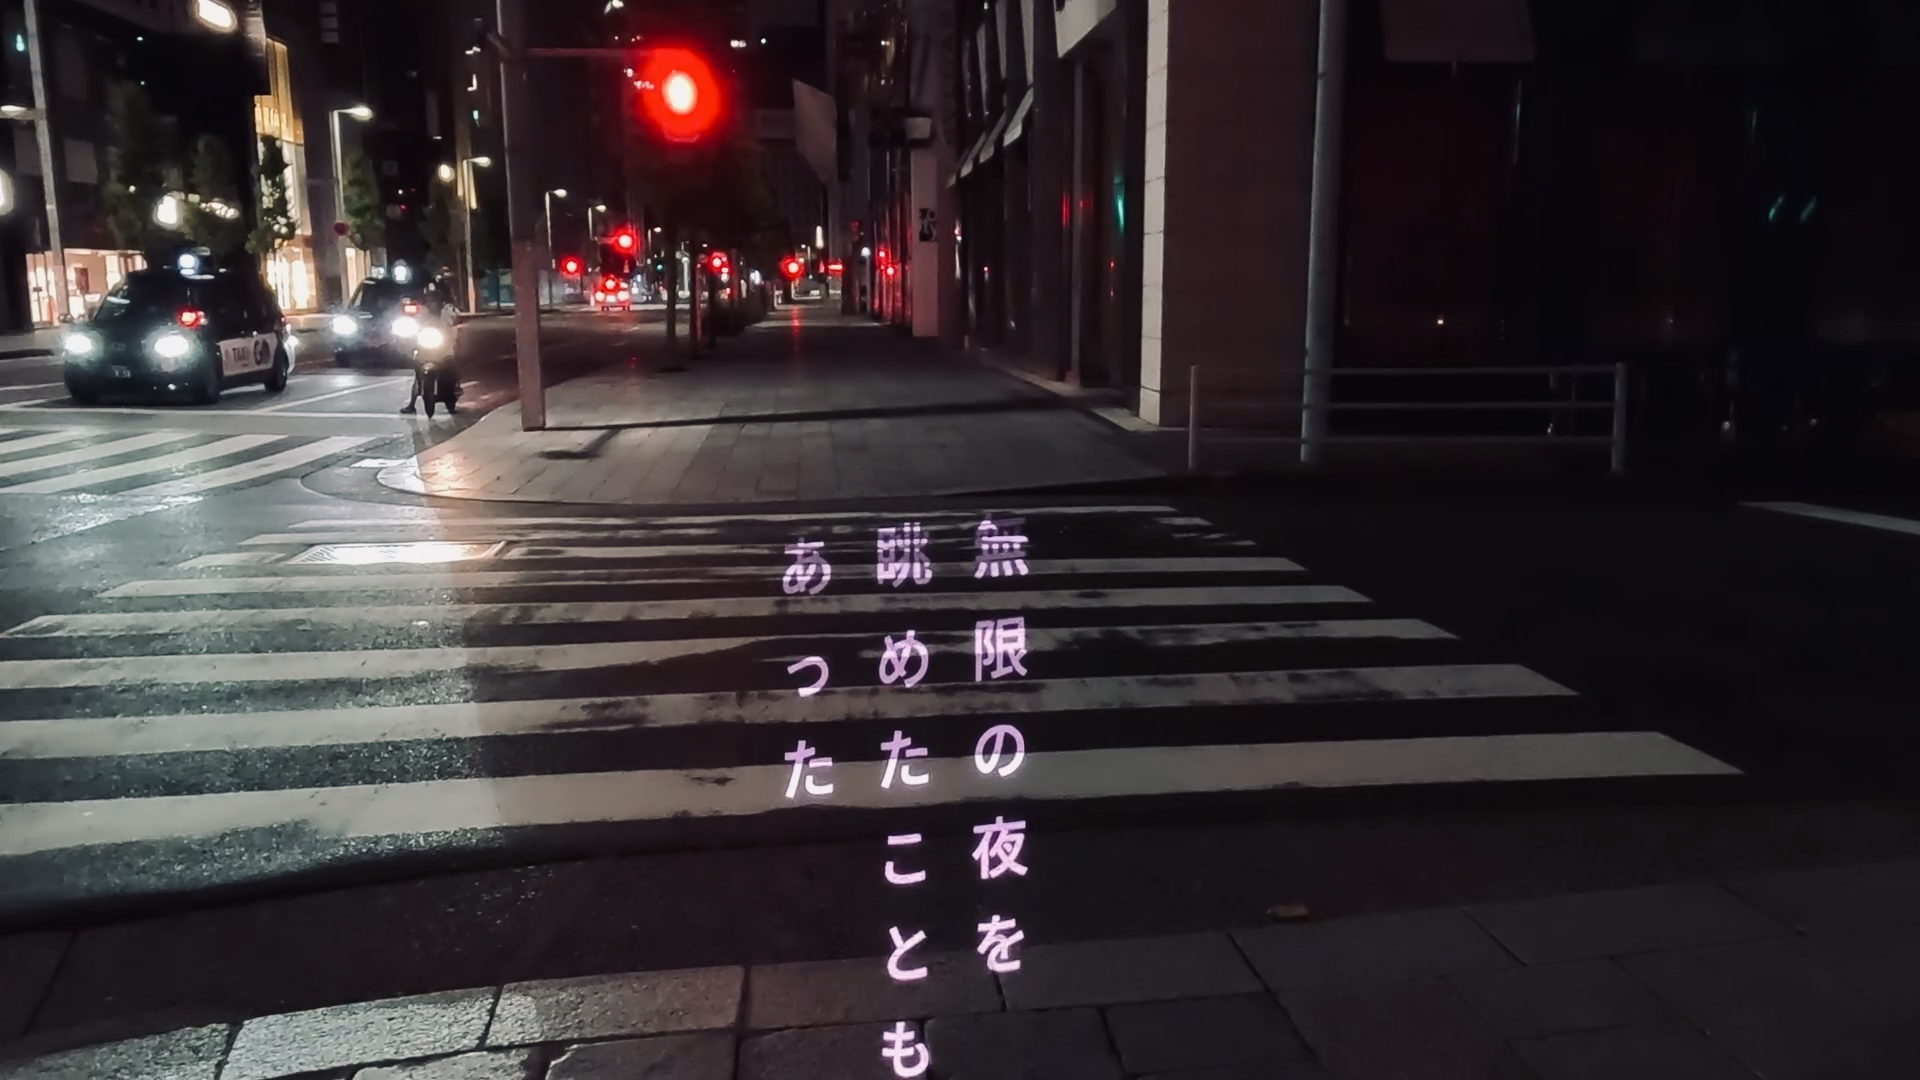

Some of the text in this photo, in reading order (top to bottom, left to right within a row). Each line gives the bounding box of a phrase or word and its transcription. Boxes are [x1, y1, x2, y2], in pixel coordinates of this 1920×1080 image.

[782, 538, 833, 799] あった
[876, 521, 932, 1078] 眺めたことも
[972, 515, 1029, 972] 無限の夜を
